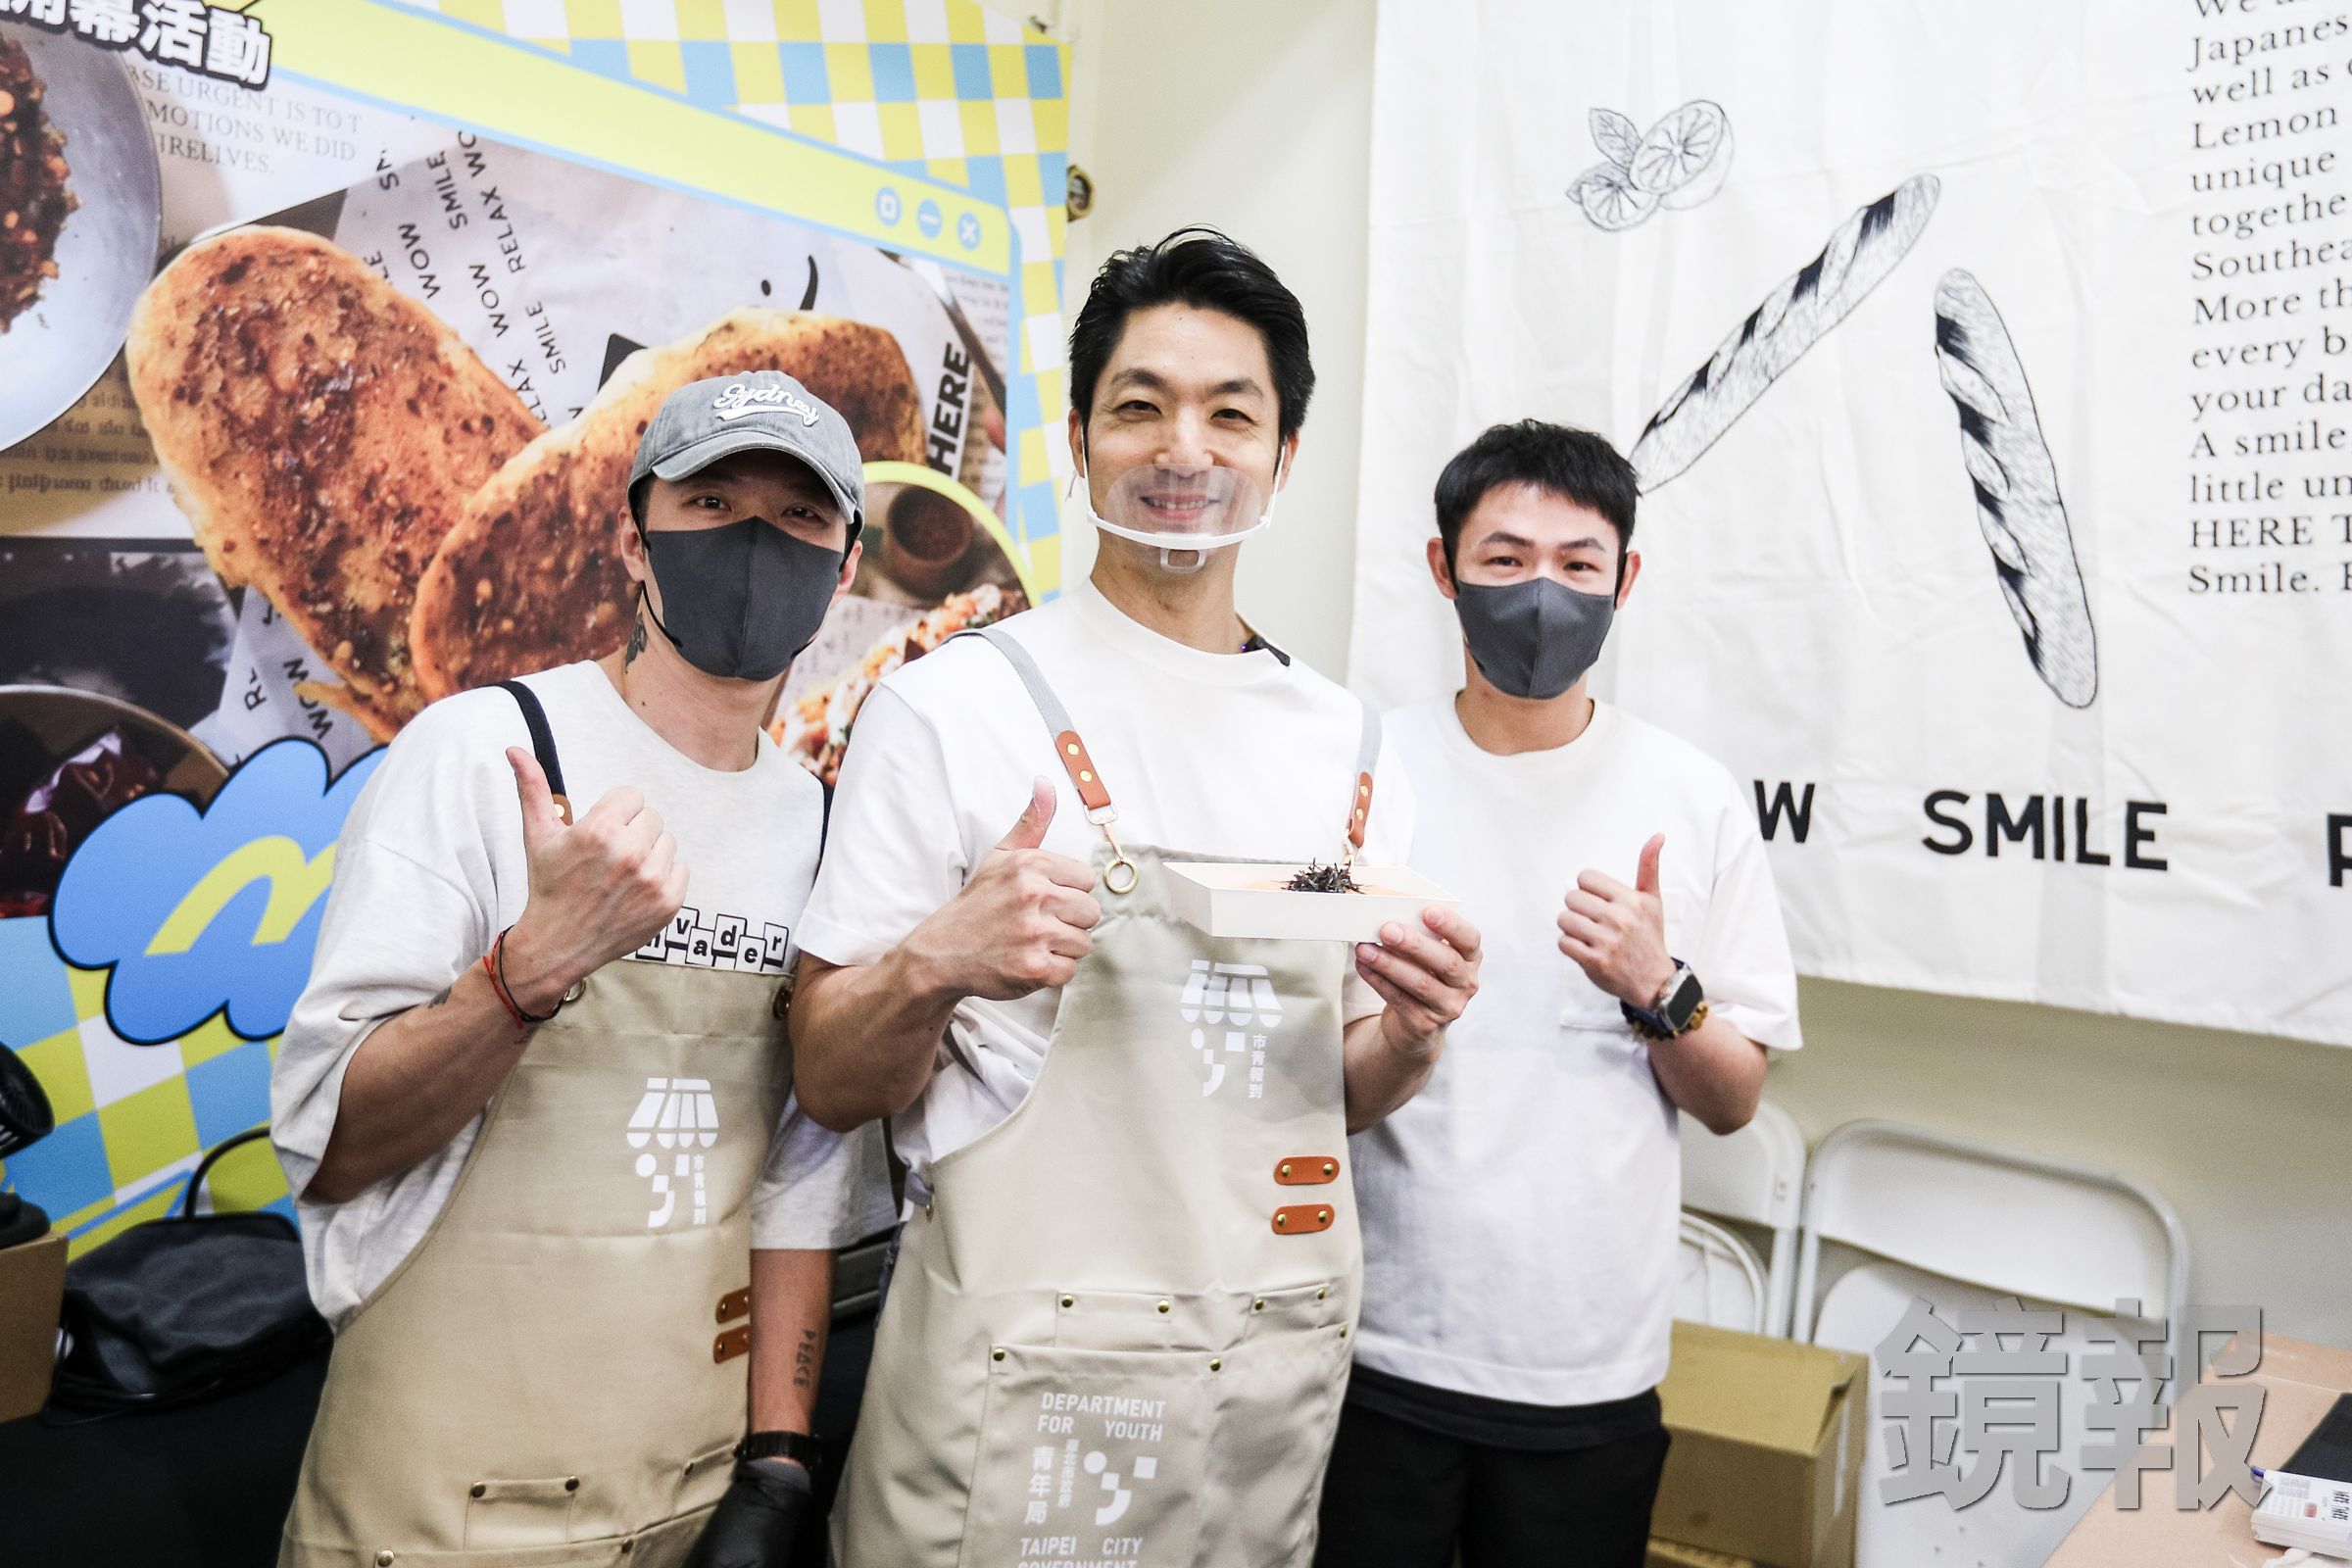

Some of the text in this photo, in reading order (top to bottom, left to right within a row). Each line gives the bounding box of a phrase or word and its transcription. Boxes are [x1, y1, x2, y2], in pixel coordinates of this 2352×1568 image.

[2184, 14, 2348, 73] Japanes
[179, 76, 277, 116] URGENT
[288, 101, 306, 122] IS
[313, 107, 341, 129] TO
[2192, 67, 2273, 103] well
[2291, 65, 2329, 90] as
[271, 125, 309, 153] WE
[315, 136, 356, 162] DID
[2192, 106, 2337, 149] Lemon
[426, 150, 468, 229] SMILE
[2191, 151, 2335, 192] unique
[480, 186, 526, 273] RELAX
[2193, 193, 2346, 239] togethe
[398, 222, 441, 299] WOW
[469, 264, 509, 337] WOW
[2193, 294, 2301, 324] More
[525, 301, 566, 374] SMILE
[2192, 338, 2304, 369] every
[712, 383, 819, 426] Sydney
[926, 342, 971, 476] HERE
[2191, 386, 2286, 422] your
[2189, 431, 2217, 459] A
[2190, 470, 2283, 503] little
[2189, 515, 2313, 549] HERE
[2188, 562, 2320, 594] Smile.
[1753, 780, 2169, 870] W SMILE
[1041, 1392, 1166, 1419] DEPARTMENT
[1037, 1414, 1163, 1442] FOR YOUTH
[1025, 1446, 1054, 1525] 青年局
[1020, 1537, 1143, 1556] TAIPEI CITY
